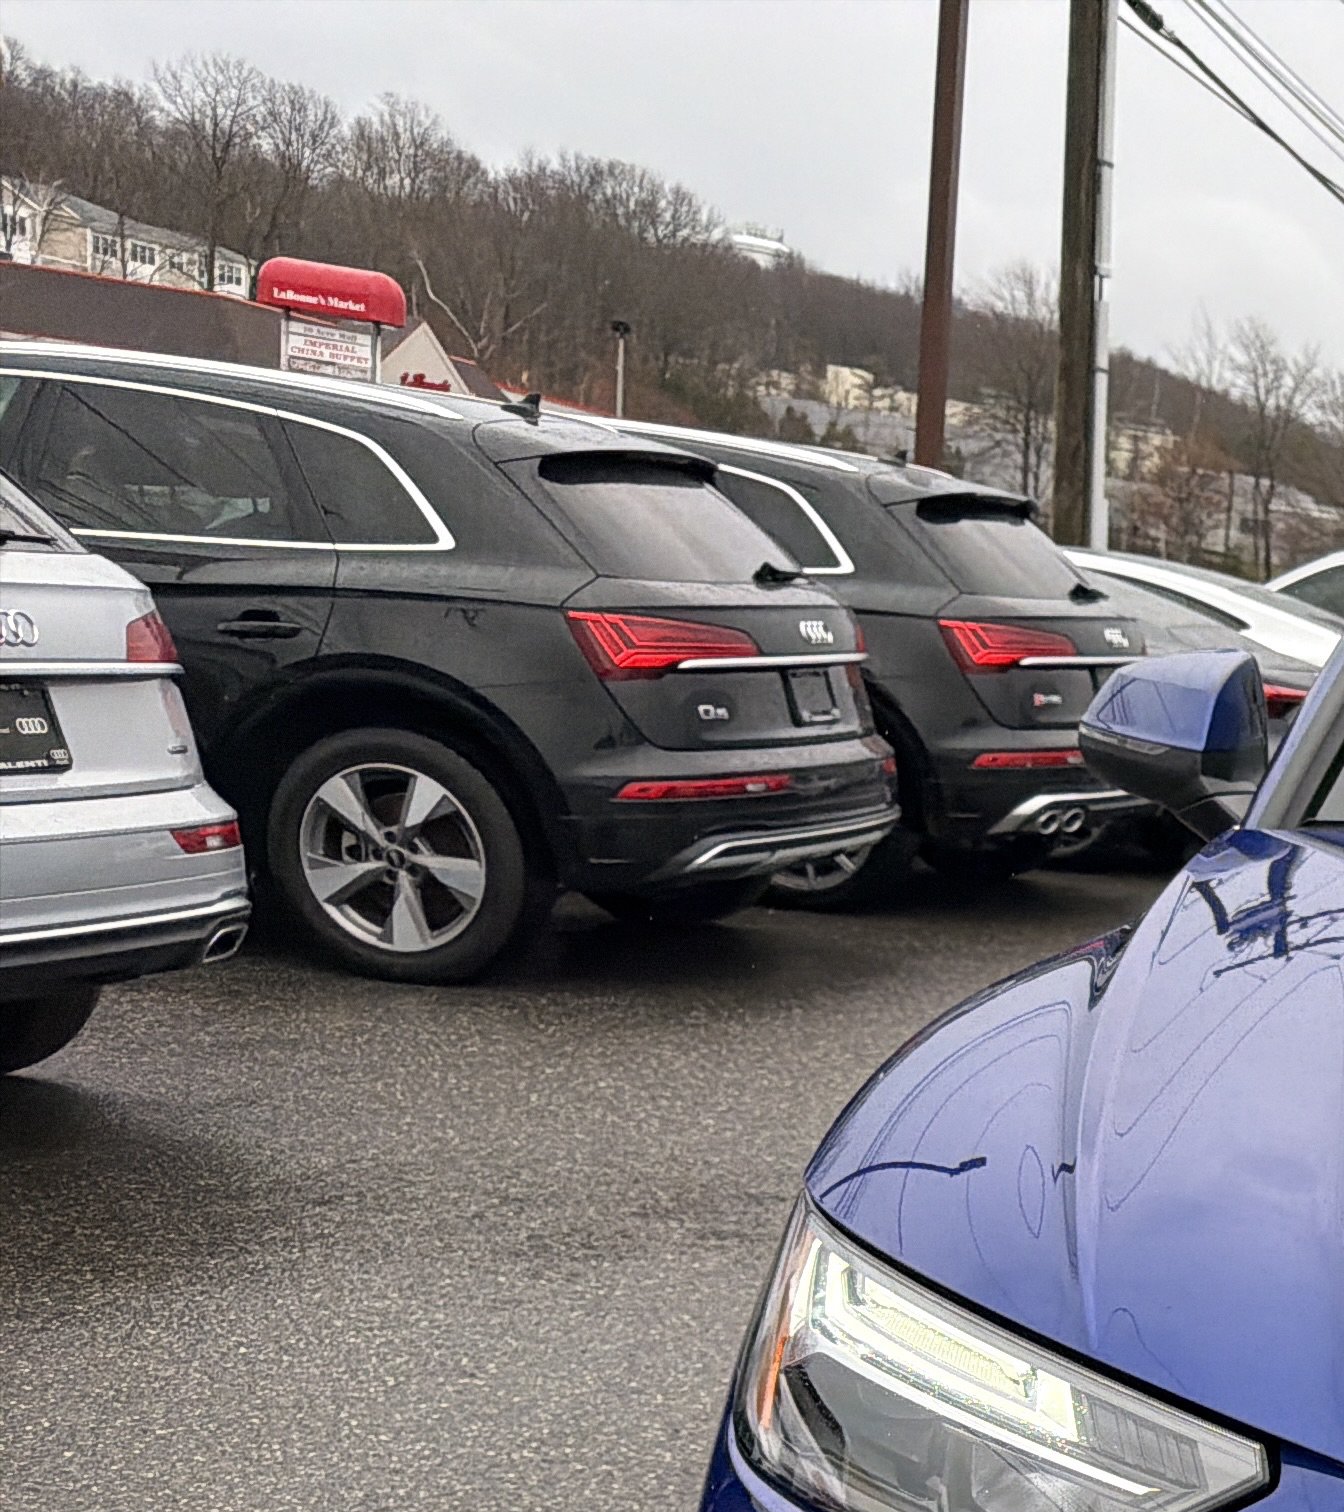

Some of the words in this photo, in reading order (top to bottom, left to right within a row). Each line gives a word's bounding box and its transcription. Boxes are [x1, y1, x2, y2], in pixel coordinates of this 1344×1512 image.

[327, 296, 366, 312] Market
[303, 338, 357, 354] IMPERIAL
[290, 345, 324, 358] CHINA
[329, 351, 369, 365] BUFFET
[697, 704, 730, 720] Q5
